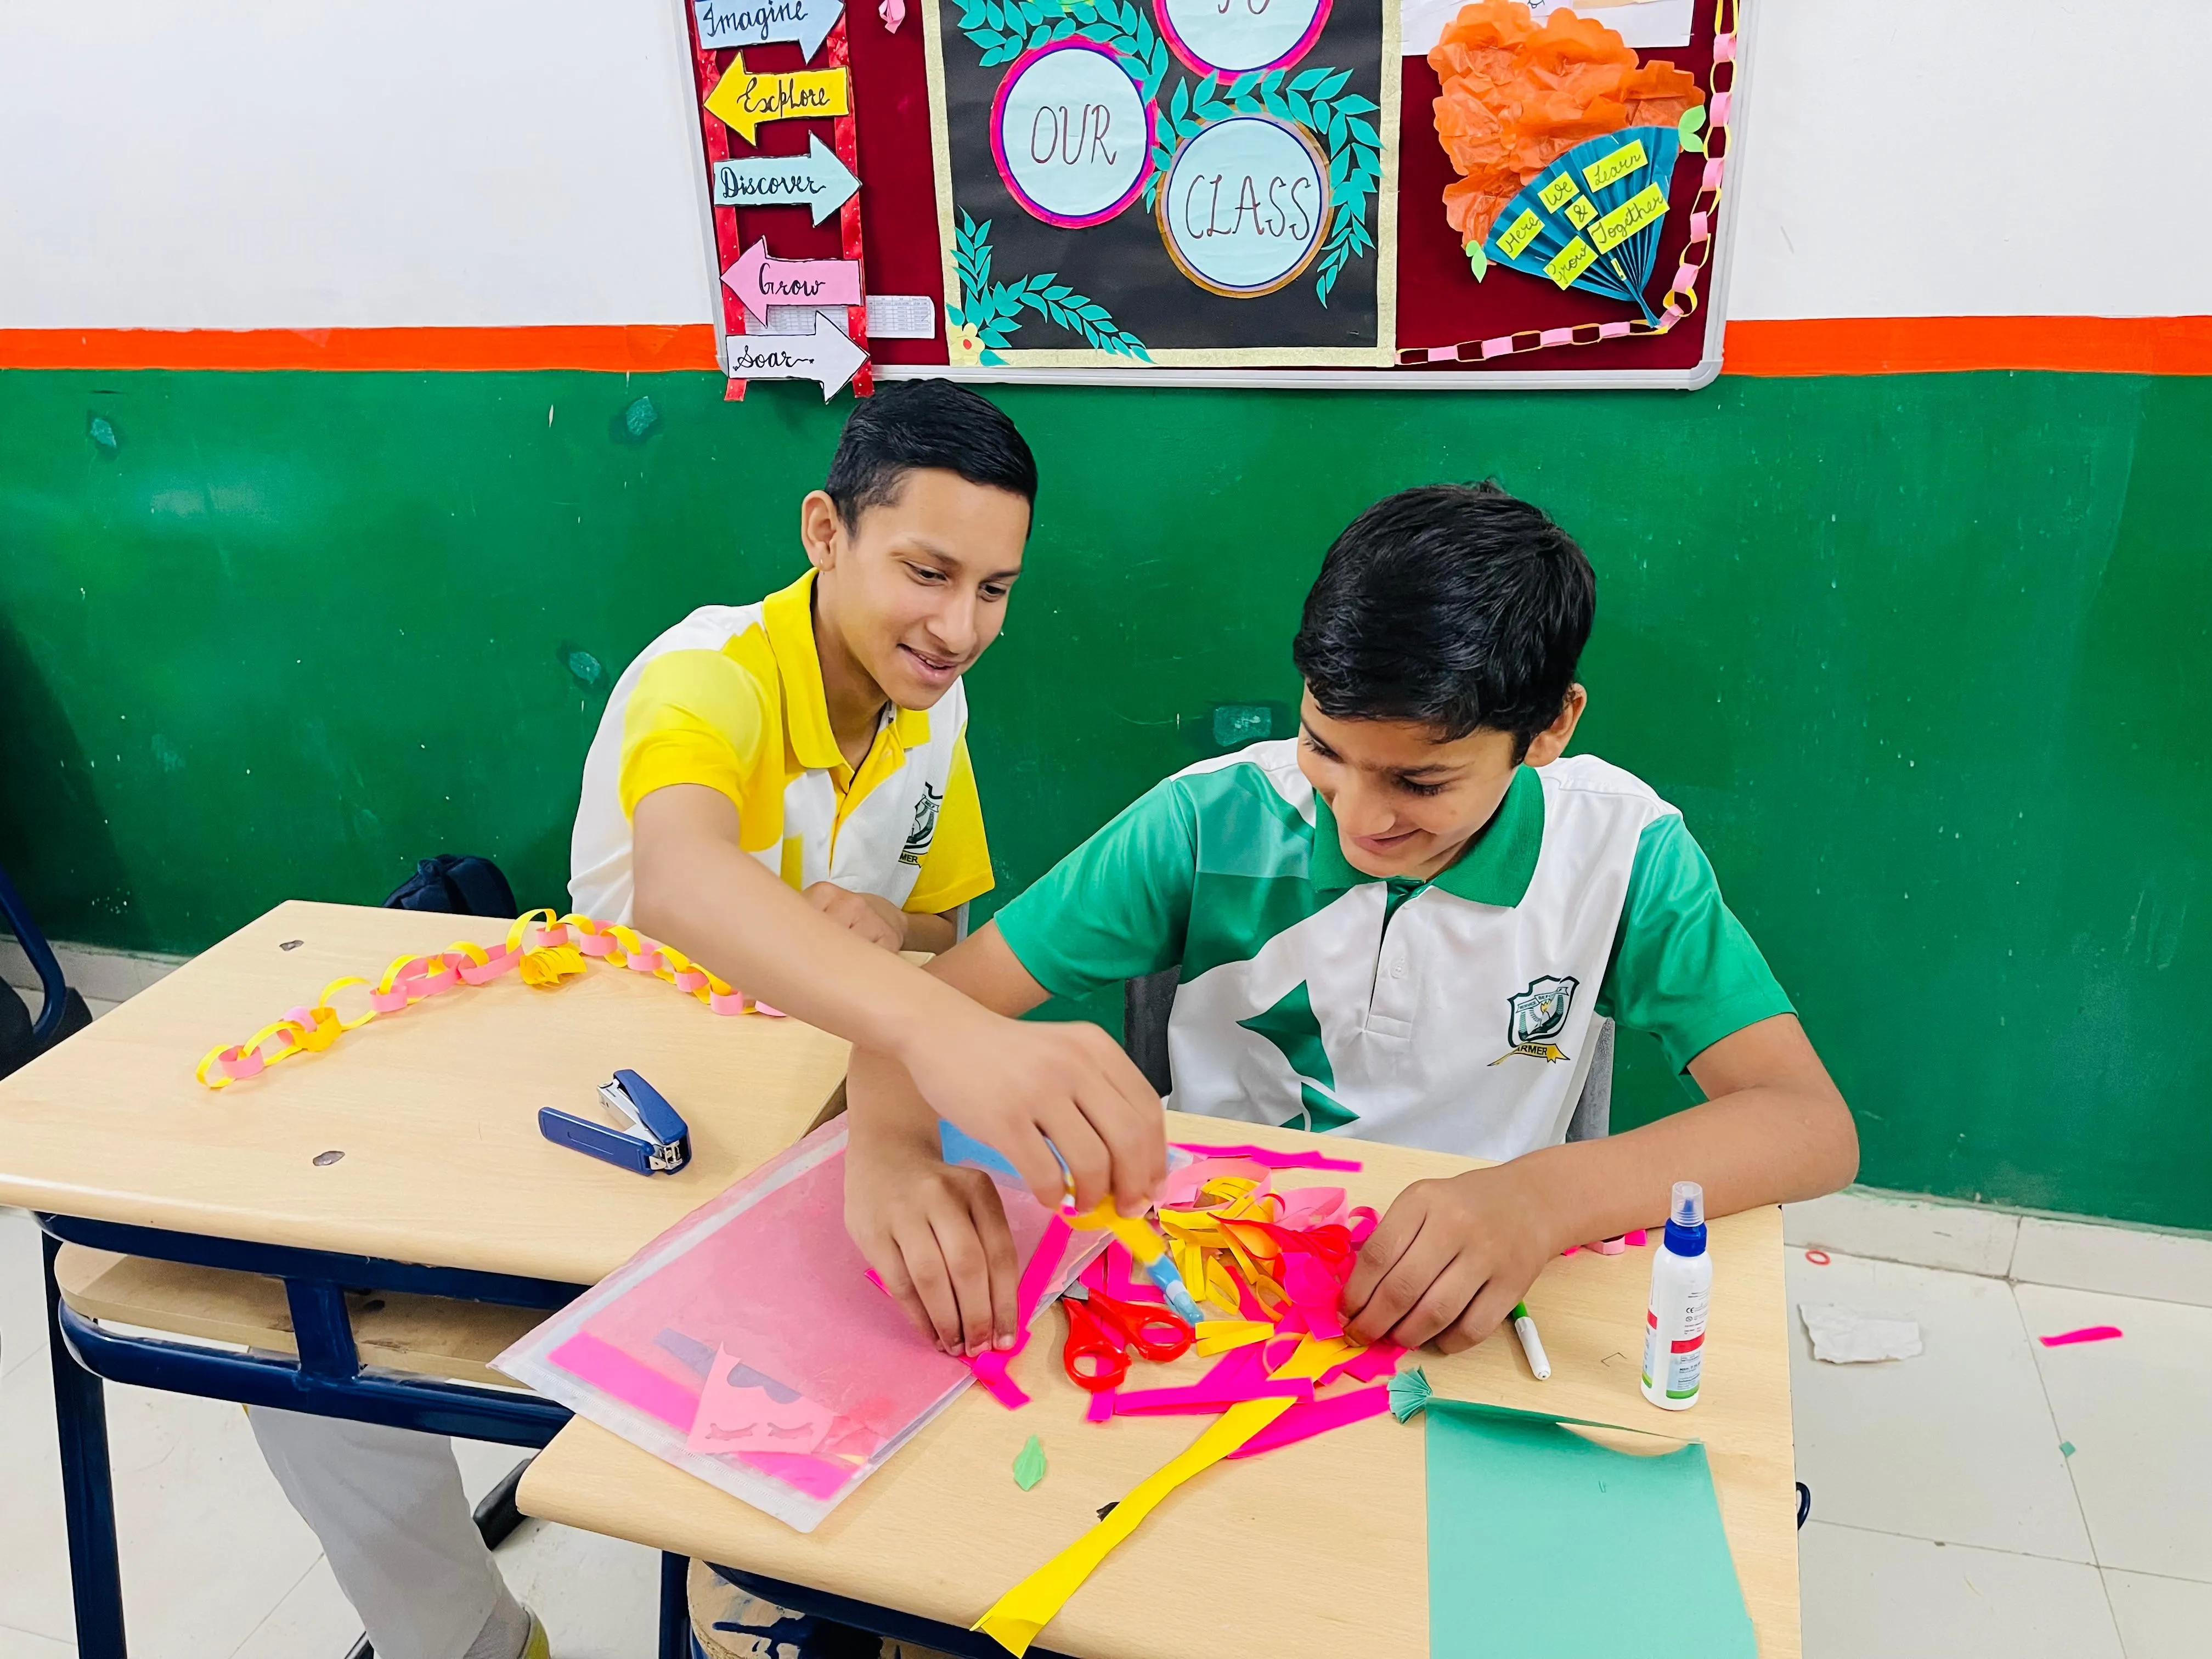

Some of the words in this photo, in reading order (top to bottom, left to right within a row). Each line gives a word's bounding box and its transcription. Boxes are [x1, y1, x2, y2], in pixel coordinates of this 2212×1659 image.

[703, 1, 809, 40] Imagine
[737, 77, 831, 118] Explore
[1030, 104, 1117, 165] OUR
[721, 167, 826, 198] Discover
[1595, 154, 1641, 186] Learn
[1185, 174, 1312, 241] CLASS
[1544, 180, 1573, 207] We
[1573, 204, 1589, 223] &
[1591, 195, 1664, 244] Together
[759, 263, 826, 296] Grow
[1544, 244, 1588, 285] Grow
[733, 345, 814, 371] Soar
